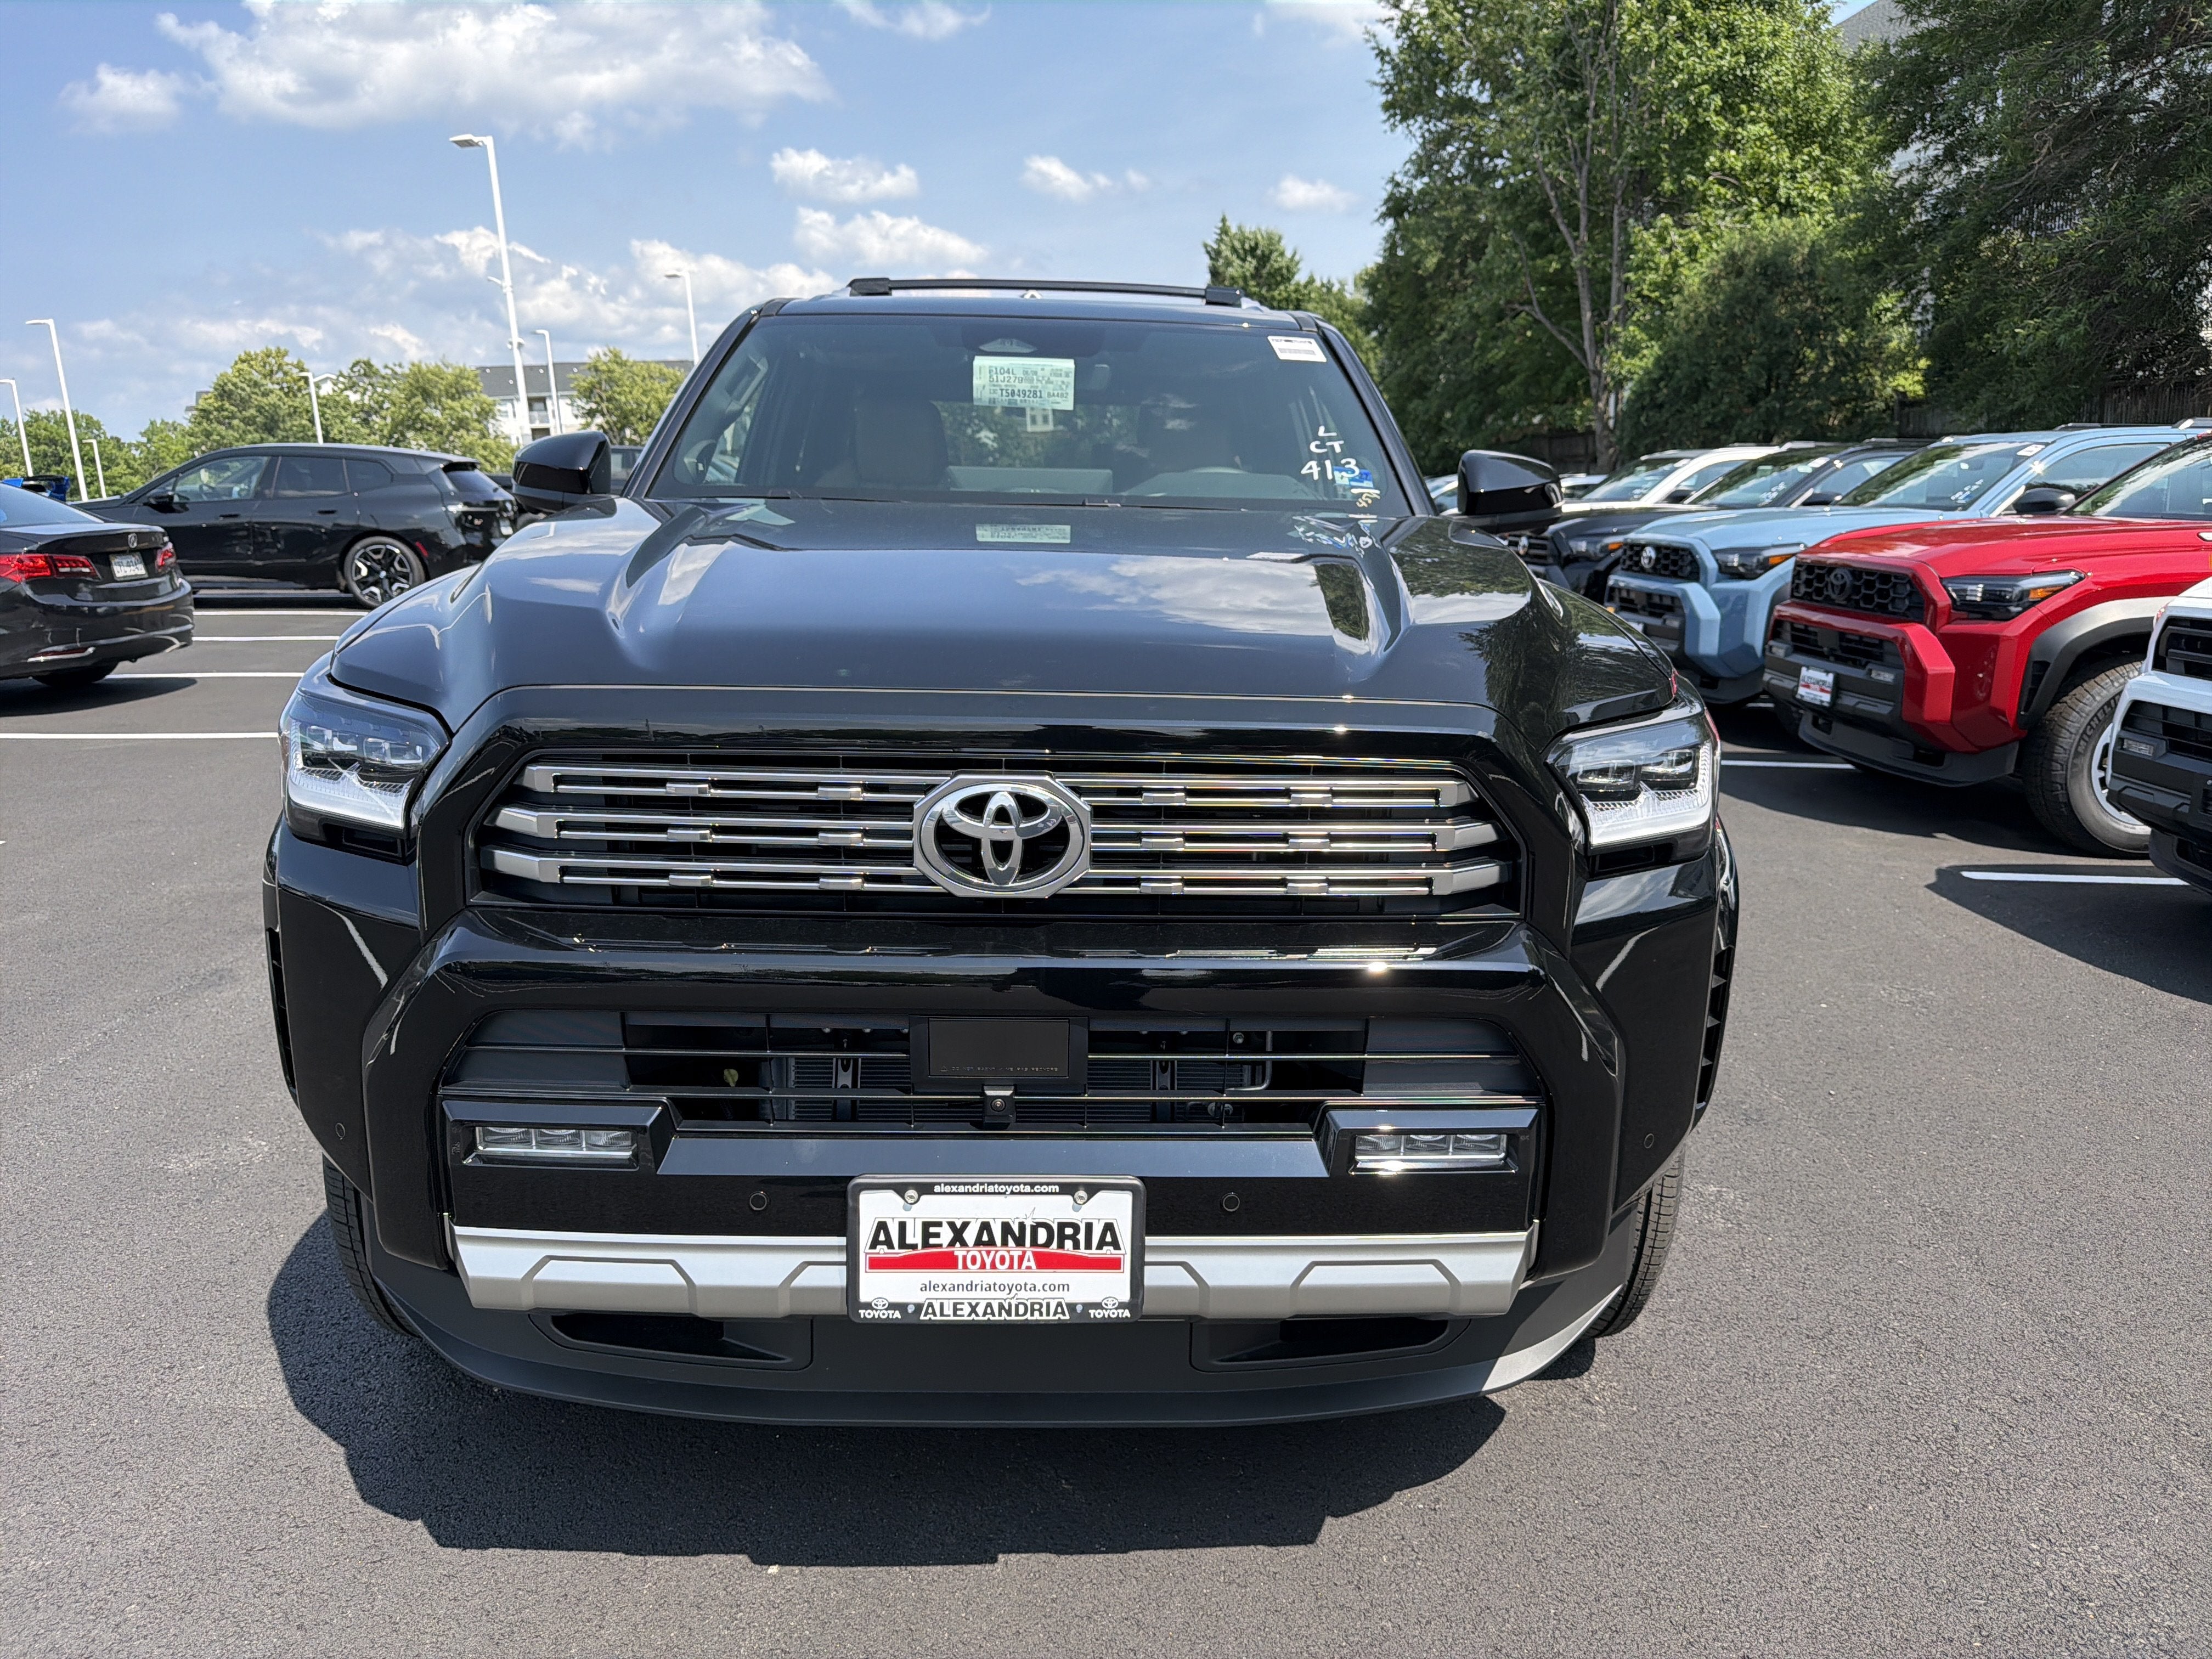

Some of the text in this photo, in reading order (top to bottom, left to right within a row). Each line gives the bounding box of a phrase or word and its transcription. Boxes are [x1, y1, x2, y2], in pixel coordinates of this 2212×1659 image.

[1310, 440, 1345, 453] CT
[1300, 458, 1361, 481] 413
[933, 1183, 1059, 1195] alexandriatoyota.com
[868, 1221, 1122, 1251] ALEXANDRIA
[954, 1250, 1037, 1269] TOYOTA
[919, 1280, 1070, 1296] alexandriatoyota.com
[859, 1299, 1131, 1319] TOYOTA ALEXANDRIA TOYOTA
